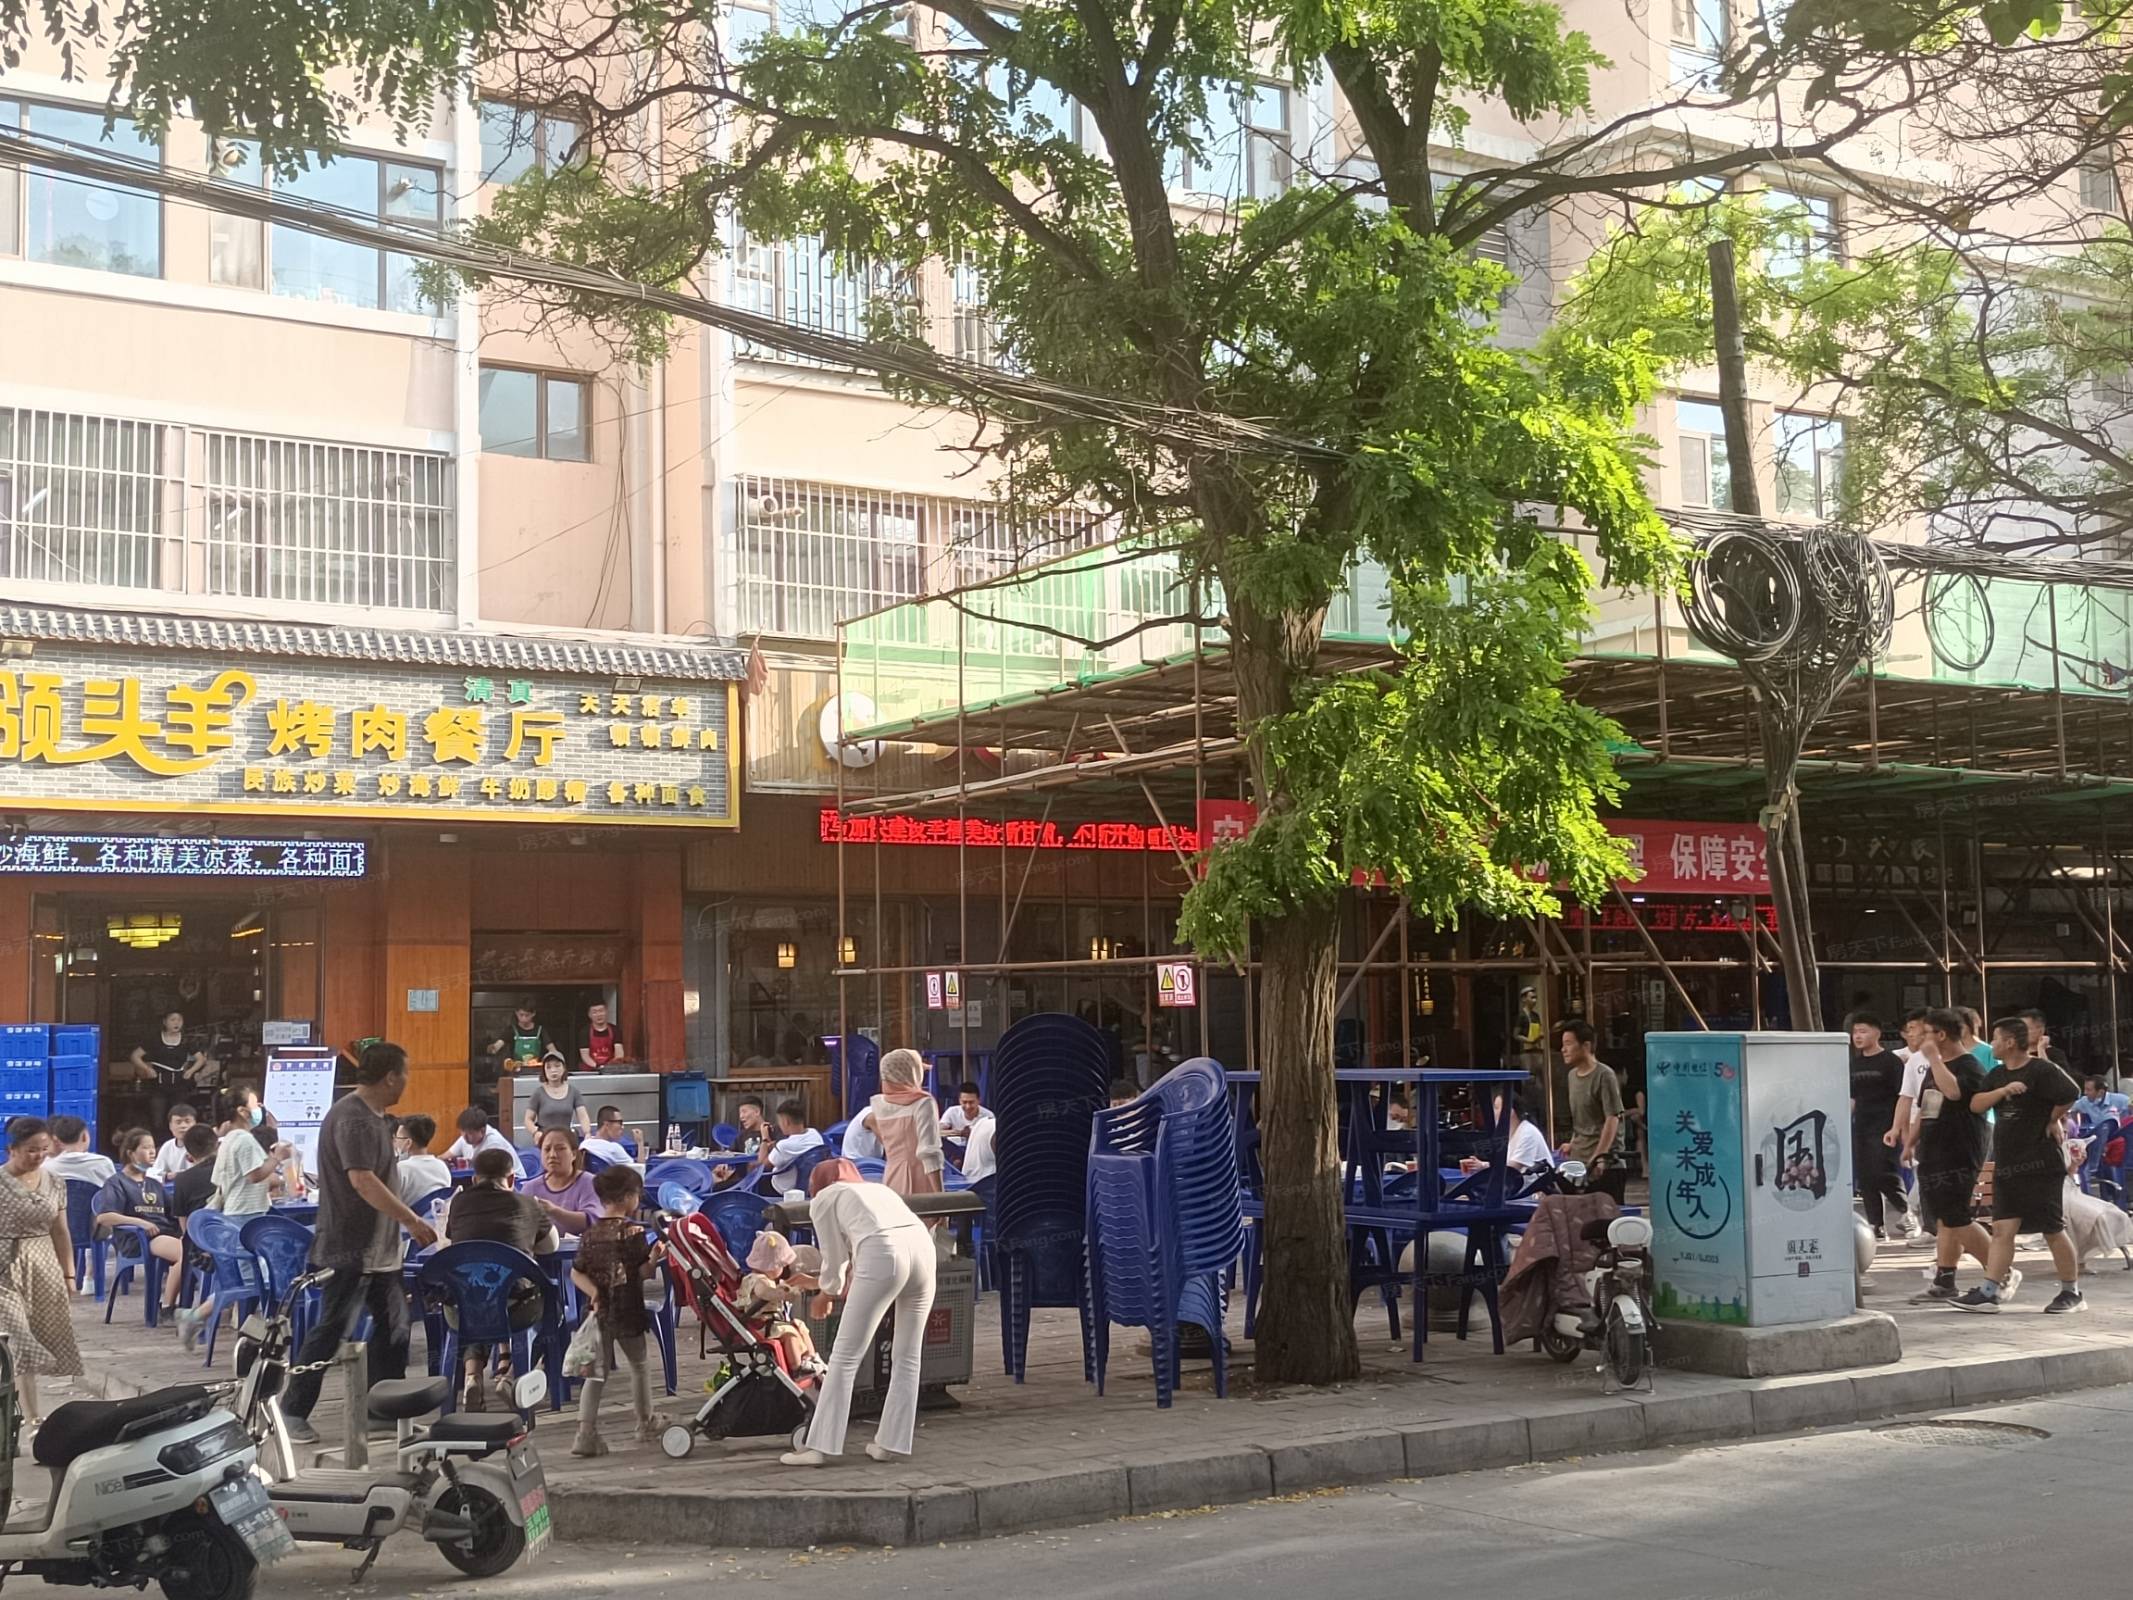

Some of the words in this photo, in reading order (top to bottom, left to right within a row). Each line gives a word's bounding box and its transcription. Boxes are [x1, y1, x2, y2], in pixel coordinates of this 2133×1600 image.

[463, 675, 535, 704] 清真
[266, 697, 567, 767] 烤肉餐厅
[243, 767, 357, 796] 民族炒菜
[377, 772, 461, 800] 炒海鲜
[607, 780, 708, 807] 各种面食
